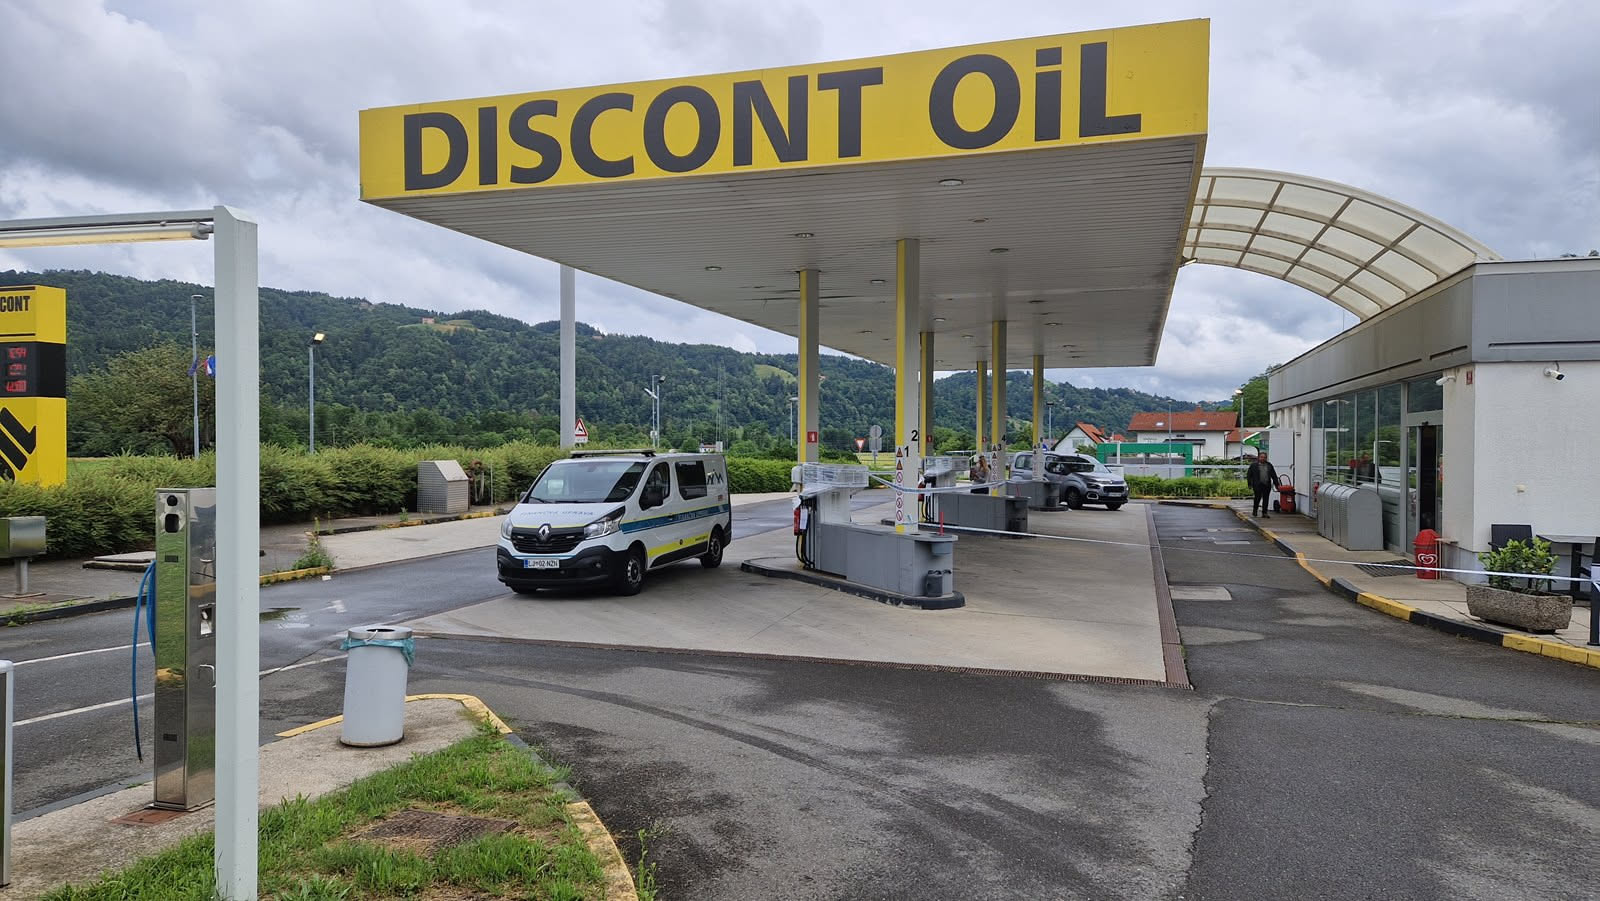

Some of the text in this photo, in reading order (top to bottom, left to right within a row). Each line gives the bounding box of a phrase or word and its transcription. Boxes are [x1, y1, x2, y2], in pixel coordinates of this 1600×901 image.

[403, 66, 884, 191] DISCONT
[911, 429, 918, 442] 2
[904, 445, 910, 457] 1
